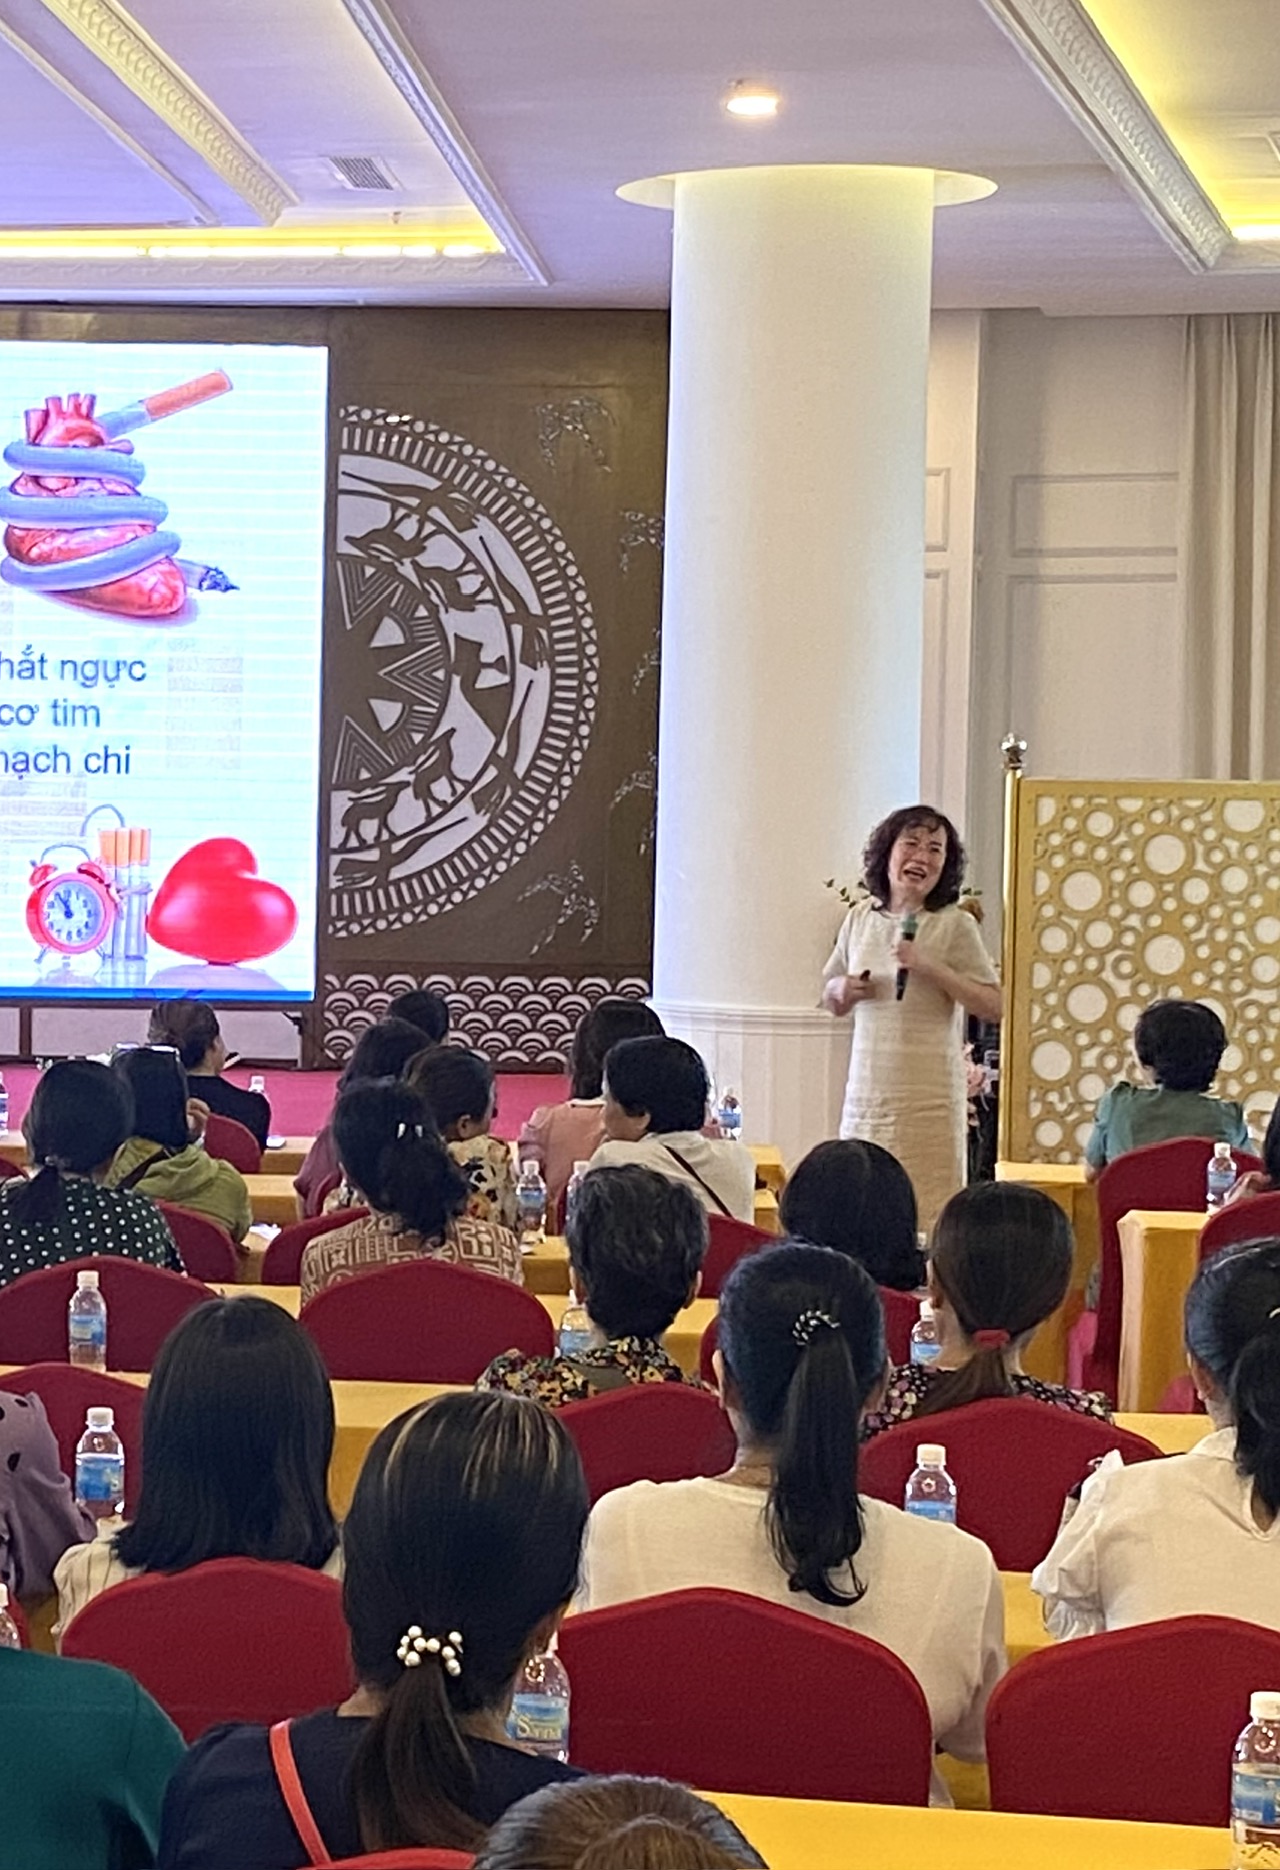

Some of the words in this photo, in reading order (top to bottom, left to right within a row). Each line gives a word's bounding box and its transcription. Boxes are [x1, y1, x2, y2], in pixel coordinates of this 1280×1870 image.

[60, 659, 147, 689] ngực
[51, 698, 100, 727] tim
[84, 744, 131, 774] chi
